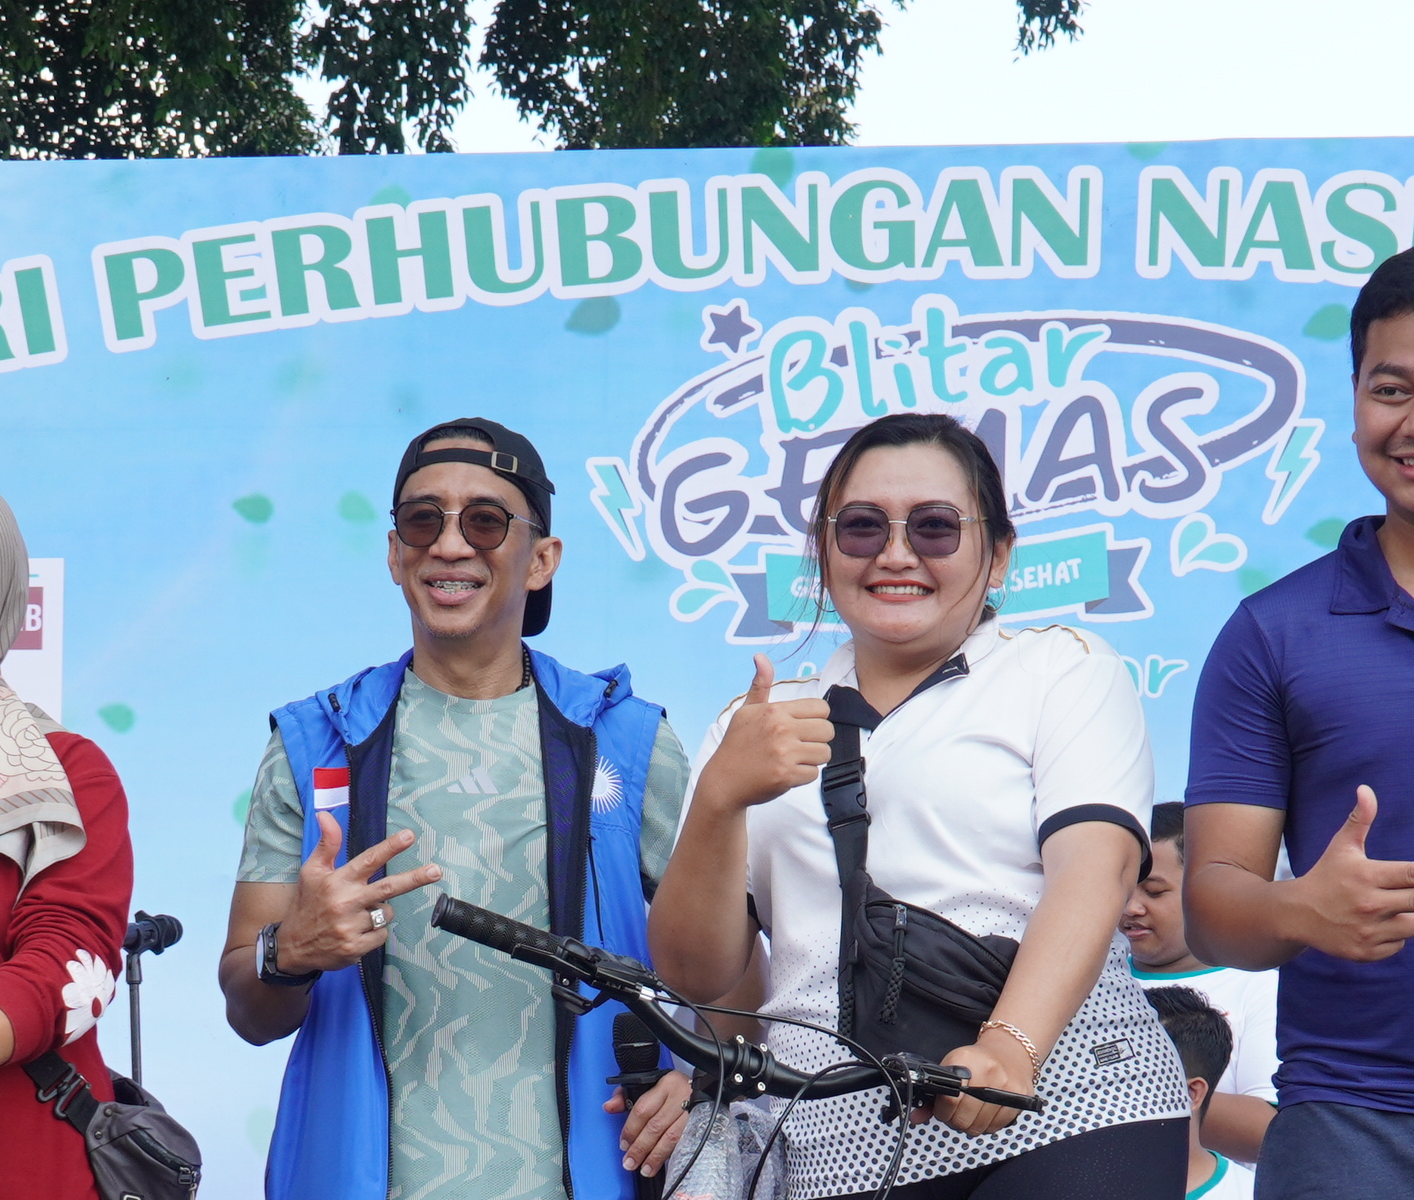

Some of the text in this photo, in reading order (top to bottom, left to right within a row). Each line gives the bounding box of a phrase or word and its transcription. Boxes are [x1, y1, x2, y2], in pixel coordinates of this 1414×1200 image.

[103, 178, 1091, 341] PERHUBUNGAN
[768, 307, 1105, 433] Blitar
[657, 384, 1210, 558] GEAS
[1009, 558, 1082, 592] SEHAT
